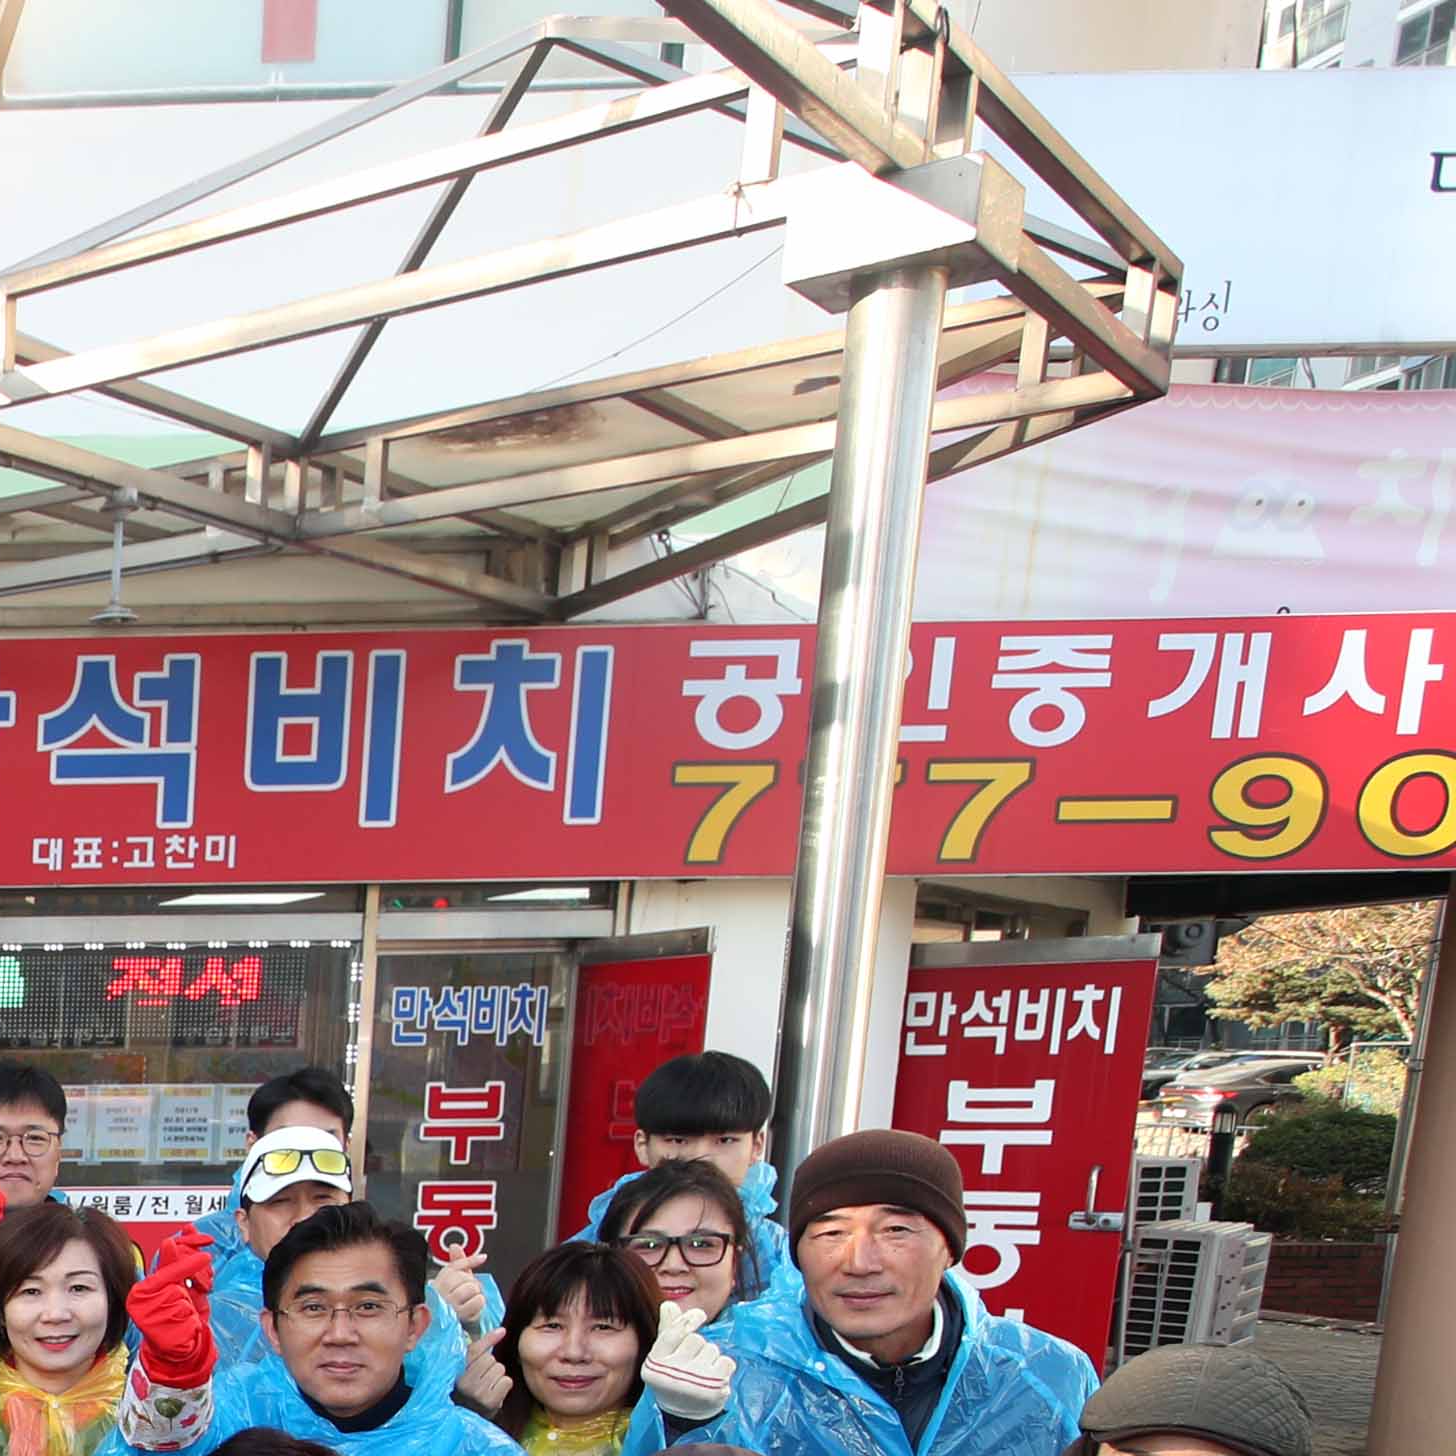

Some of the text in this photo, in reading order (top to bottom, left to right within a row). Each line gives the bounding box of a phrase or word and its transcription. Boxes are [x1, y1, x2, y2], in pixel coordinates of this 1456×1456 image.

[671, 750, 1456, 866] 77-90
[31, 834, 237, 871] 대표:고찬미
[390, 983, 549, 1047] 만석비치
[904, 983, 1123, 1056] 만석비치
[938, 1079, 1056, 1322] 부동
